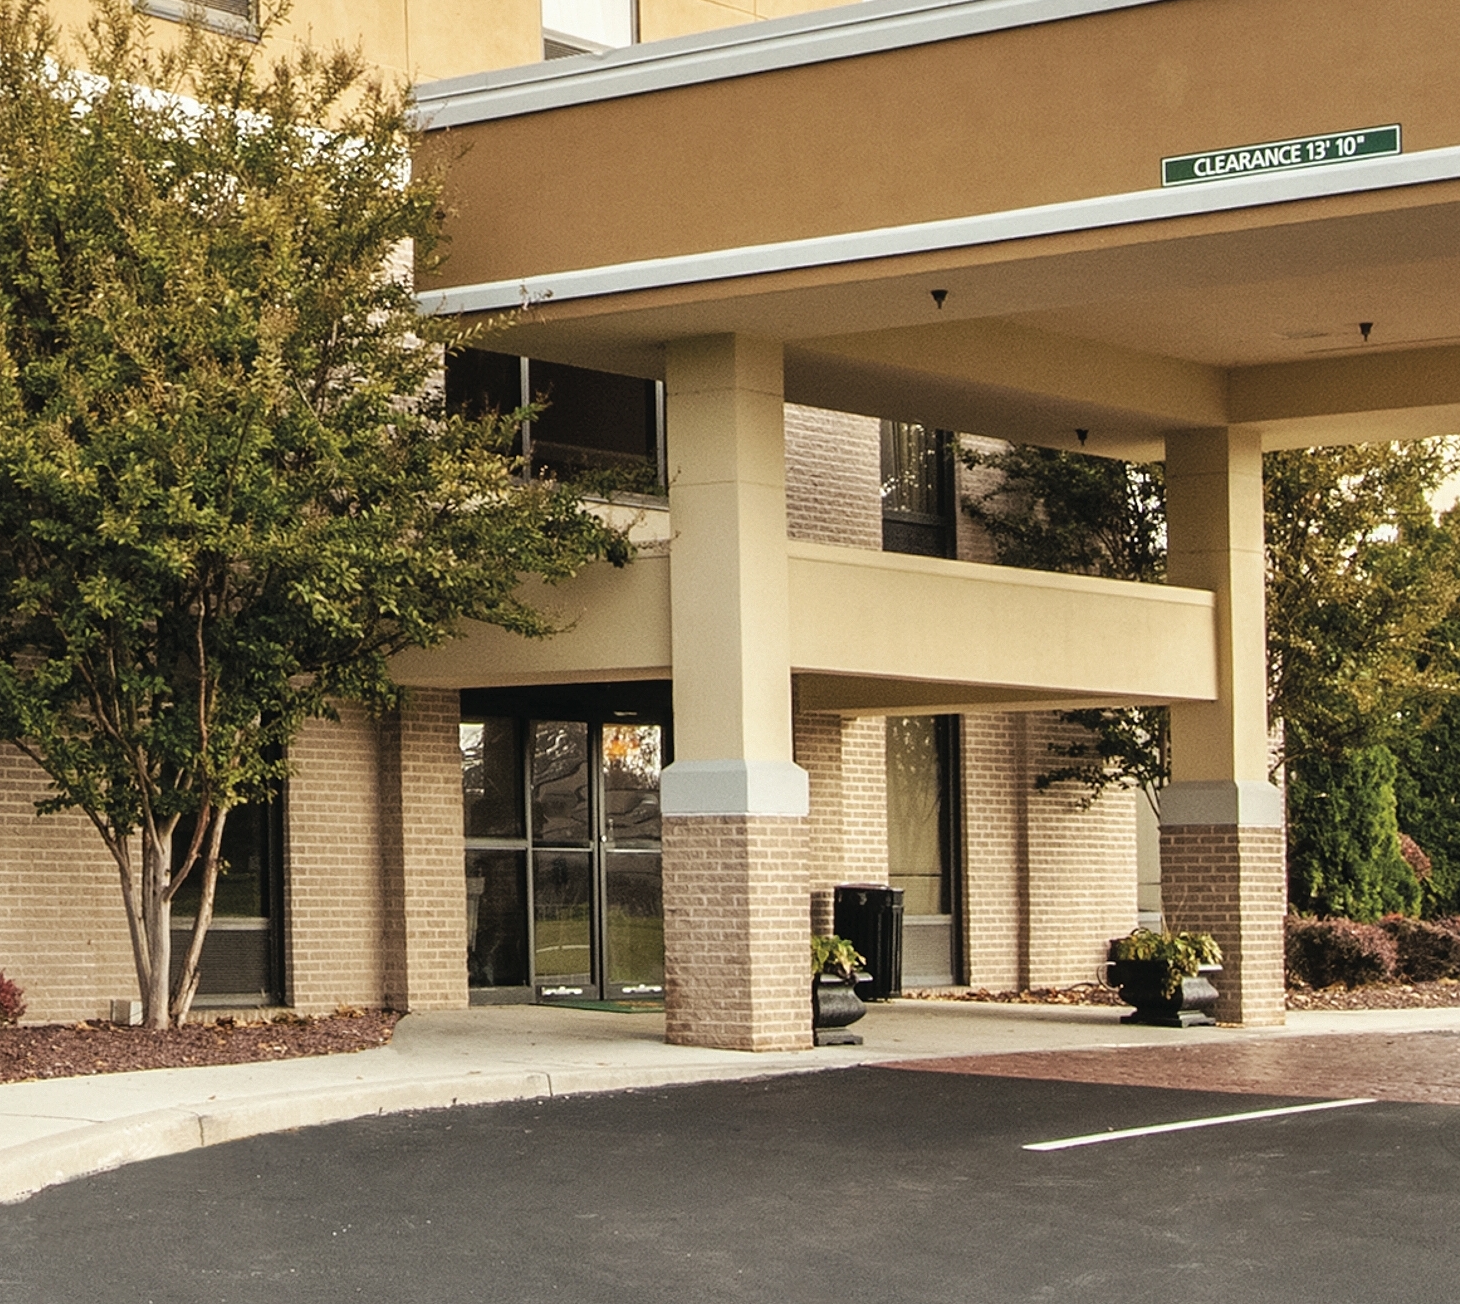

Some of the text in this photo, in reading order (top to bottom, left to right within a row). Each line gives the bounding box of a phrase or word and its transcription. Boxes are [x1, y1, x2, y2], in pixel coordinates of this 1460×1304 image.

[1193, 135, 1365, 177] CLEARANCE 13' 10"
